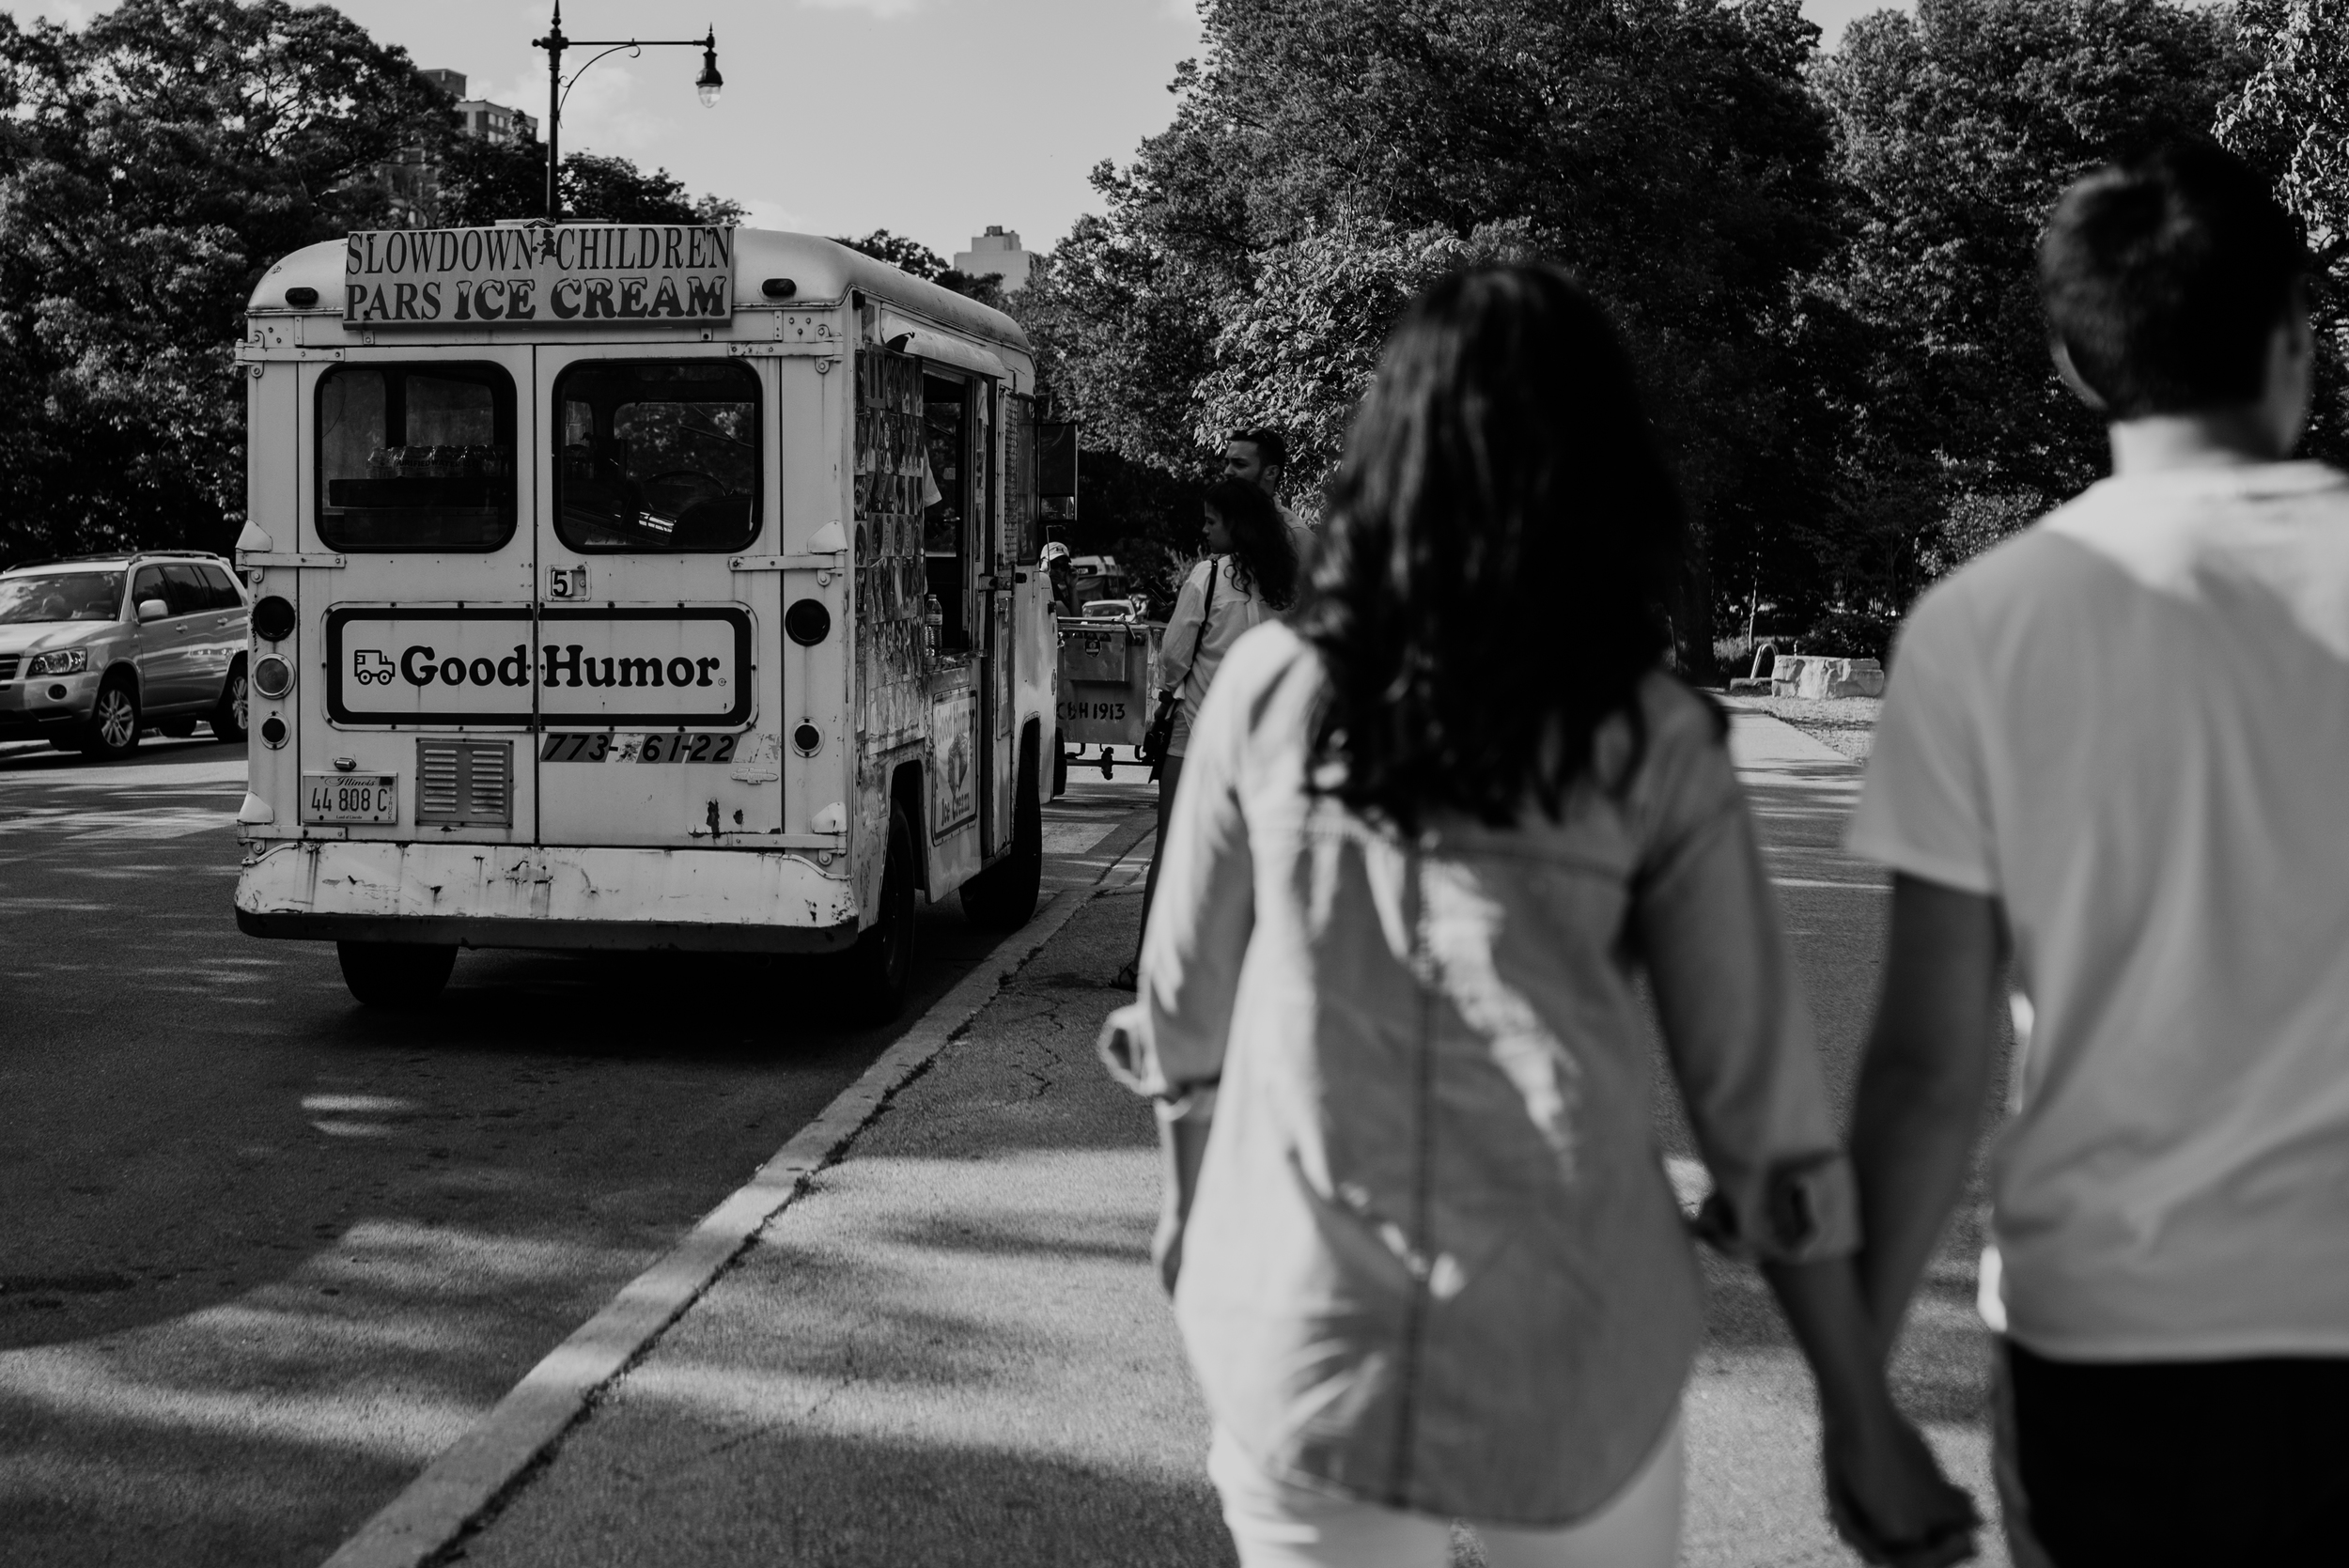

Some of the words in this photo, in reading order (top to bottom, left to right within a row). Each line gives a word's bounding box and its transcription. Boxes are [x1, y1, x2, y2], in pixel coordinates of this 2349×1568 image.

[346, 229, 534, 274] SLOWDOWN
[555, 226, 733, 271] CHILDREN
[345, 281, 441, 322] PARS
[454, 279, 536, 320] ICE
[551, 276, 727, 320] CREAM
[553, 570, 568, 597] 5
[400, 644, 530, 687] Good
[542, 644, 720, 687] Humor
[1093, 703, 1126, 720] 1913
[325, 776, 376, 786] Illinois
[311, 787, 332, 812] 44
[339, 787, 371, 812] 808
[378, 788, 387, 812] C
